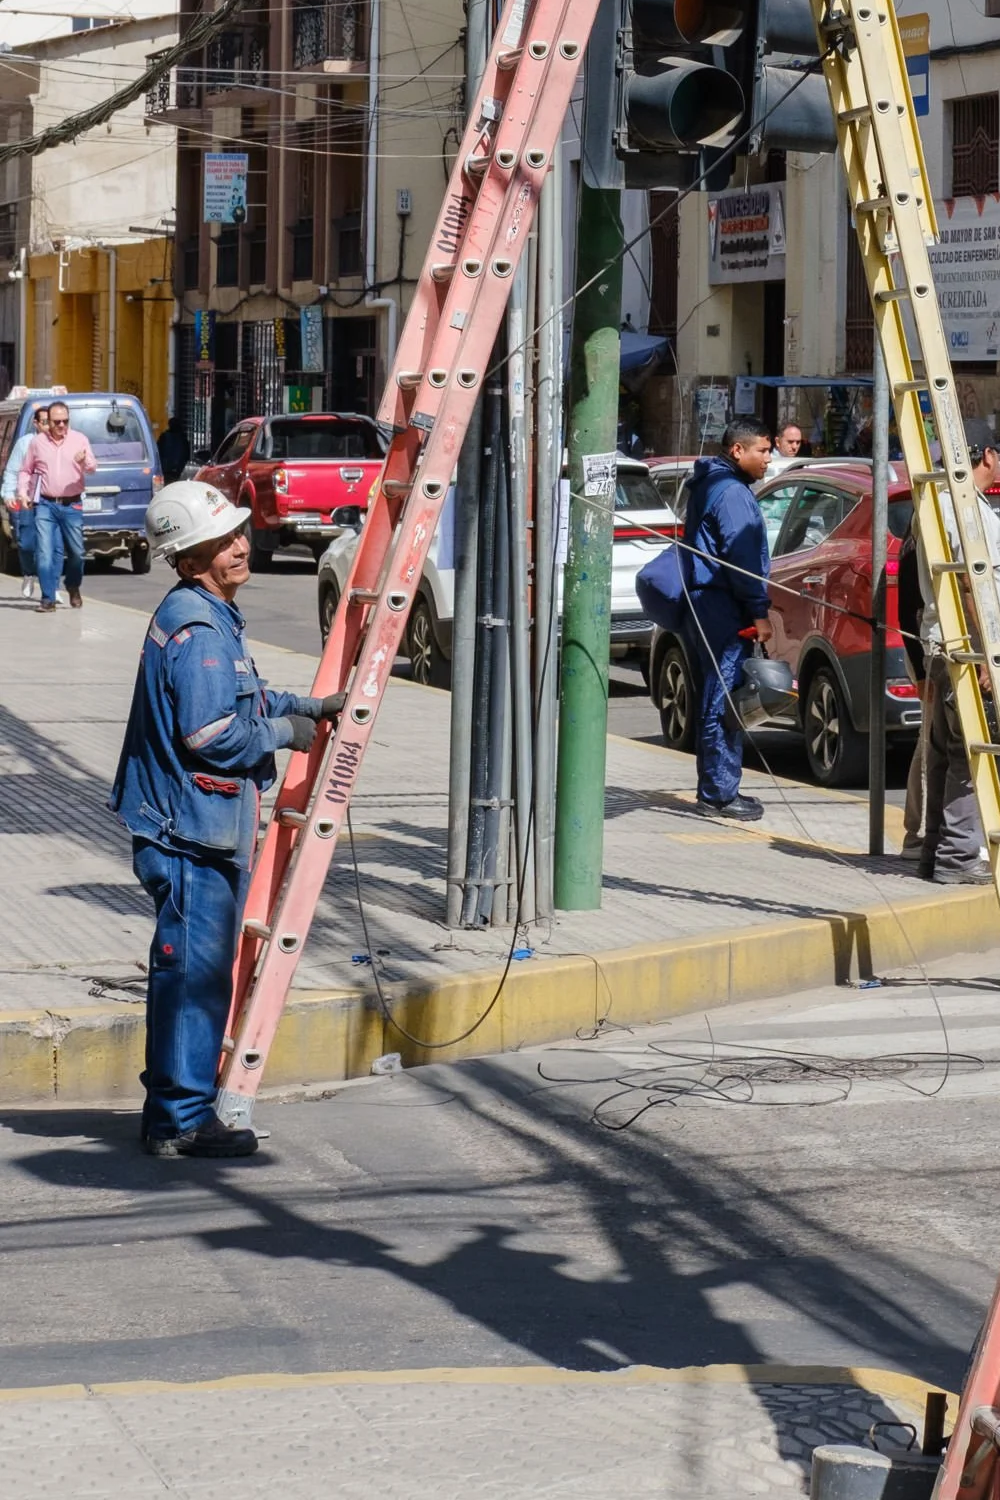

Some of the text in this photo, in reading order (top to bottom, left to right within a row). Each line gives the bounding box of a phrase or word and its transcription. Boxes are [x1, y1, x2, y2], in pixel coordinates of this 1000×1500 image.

[951, 228, 973, 244] MAYOR
[974, 227, 982, 242] DE
[984, 226, 996, 241] SAN
[954, 250, 962, 263] DE
[325, 740, 362, 804] 01084
